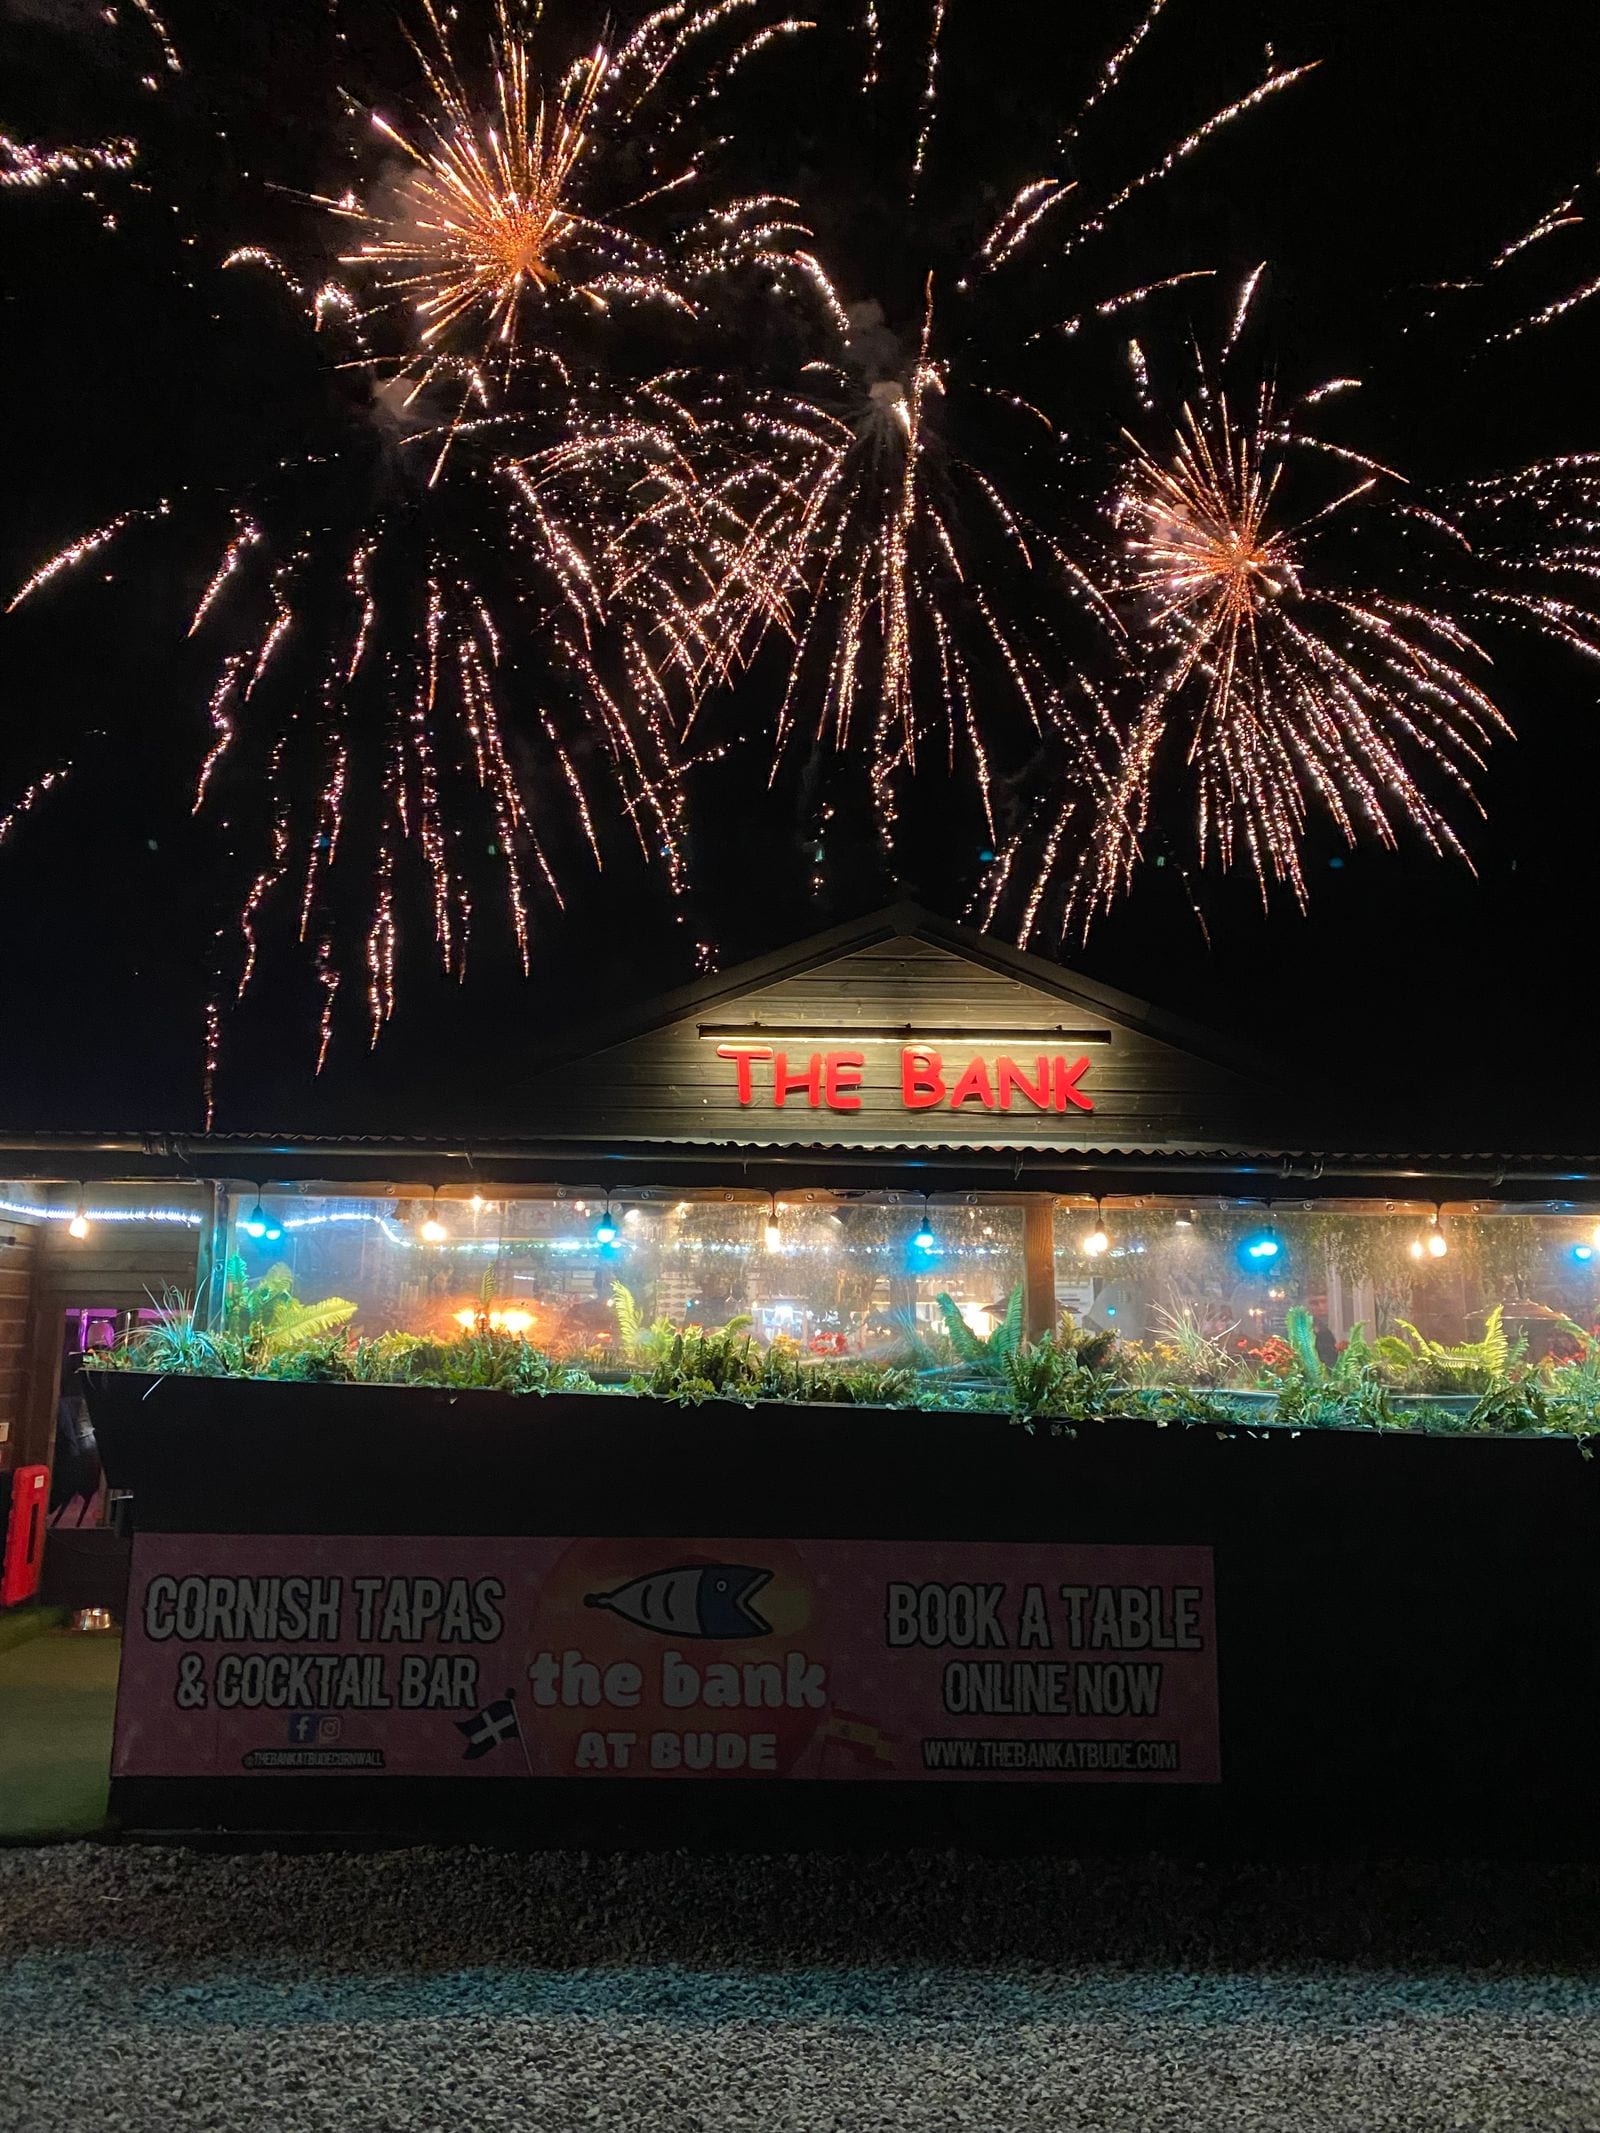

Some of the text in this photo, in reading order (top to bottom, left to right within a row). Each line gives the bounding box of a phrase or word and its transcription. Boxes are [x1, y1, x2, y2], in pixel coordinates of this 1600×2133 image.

[716, 1044, 1094, 1112] THE BANK
[146, 1575, 504, 1642] CORNISH TAPAS
[887, 1583, 1202, 1650] BOOK A TABLE
[176, 1652, 479, 1708] & COCKTAIL BAR
[529, 1650, 827, 1709] the bank
[944, 1661, 1161, 1715] ONLINE NOW
[574, 1732, 777, 1770] AT BUDE
[924, 1741, 1178, 1769] WWW.THEBANKATBUDE.COM
